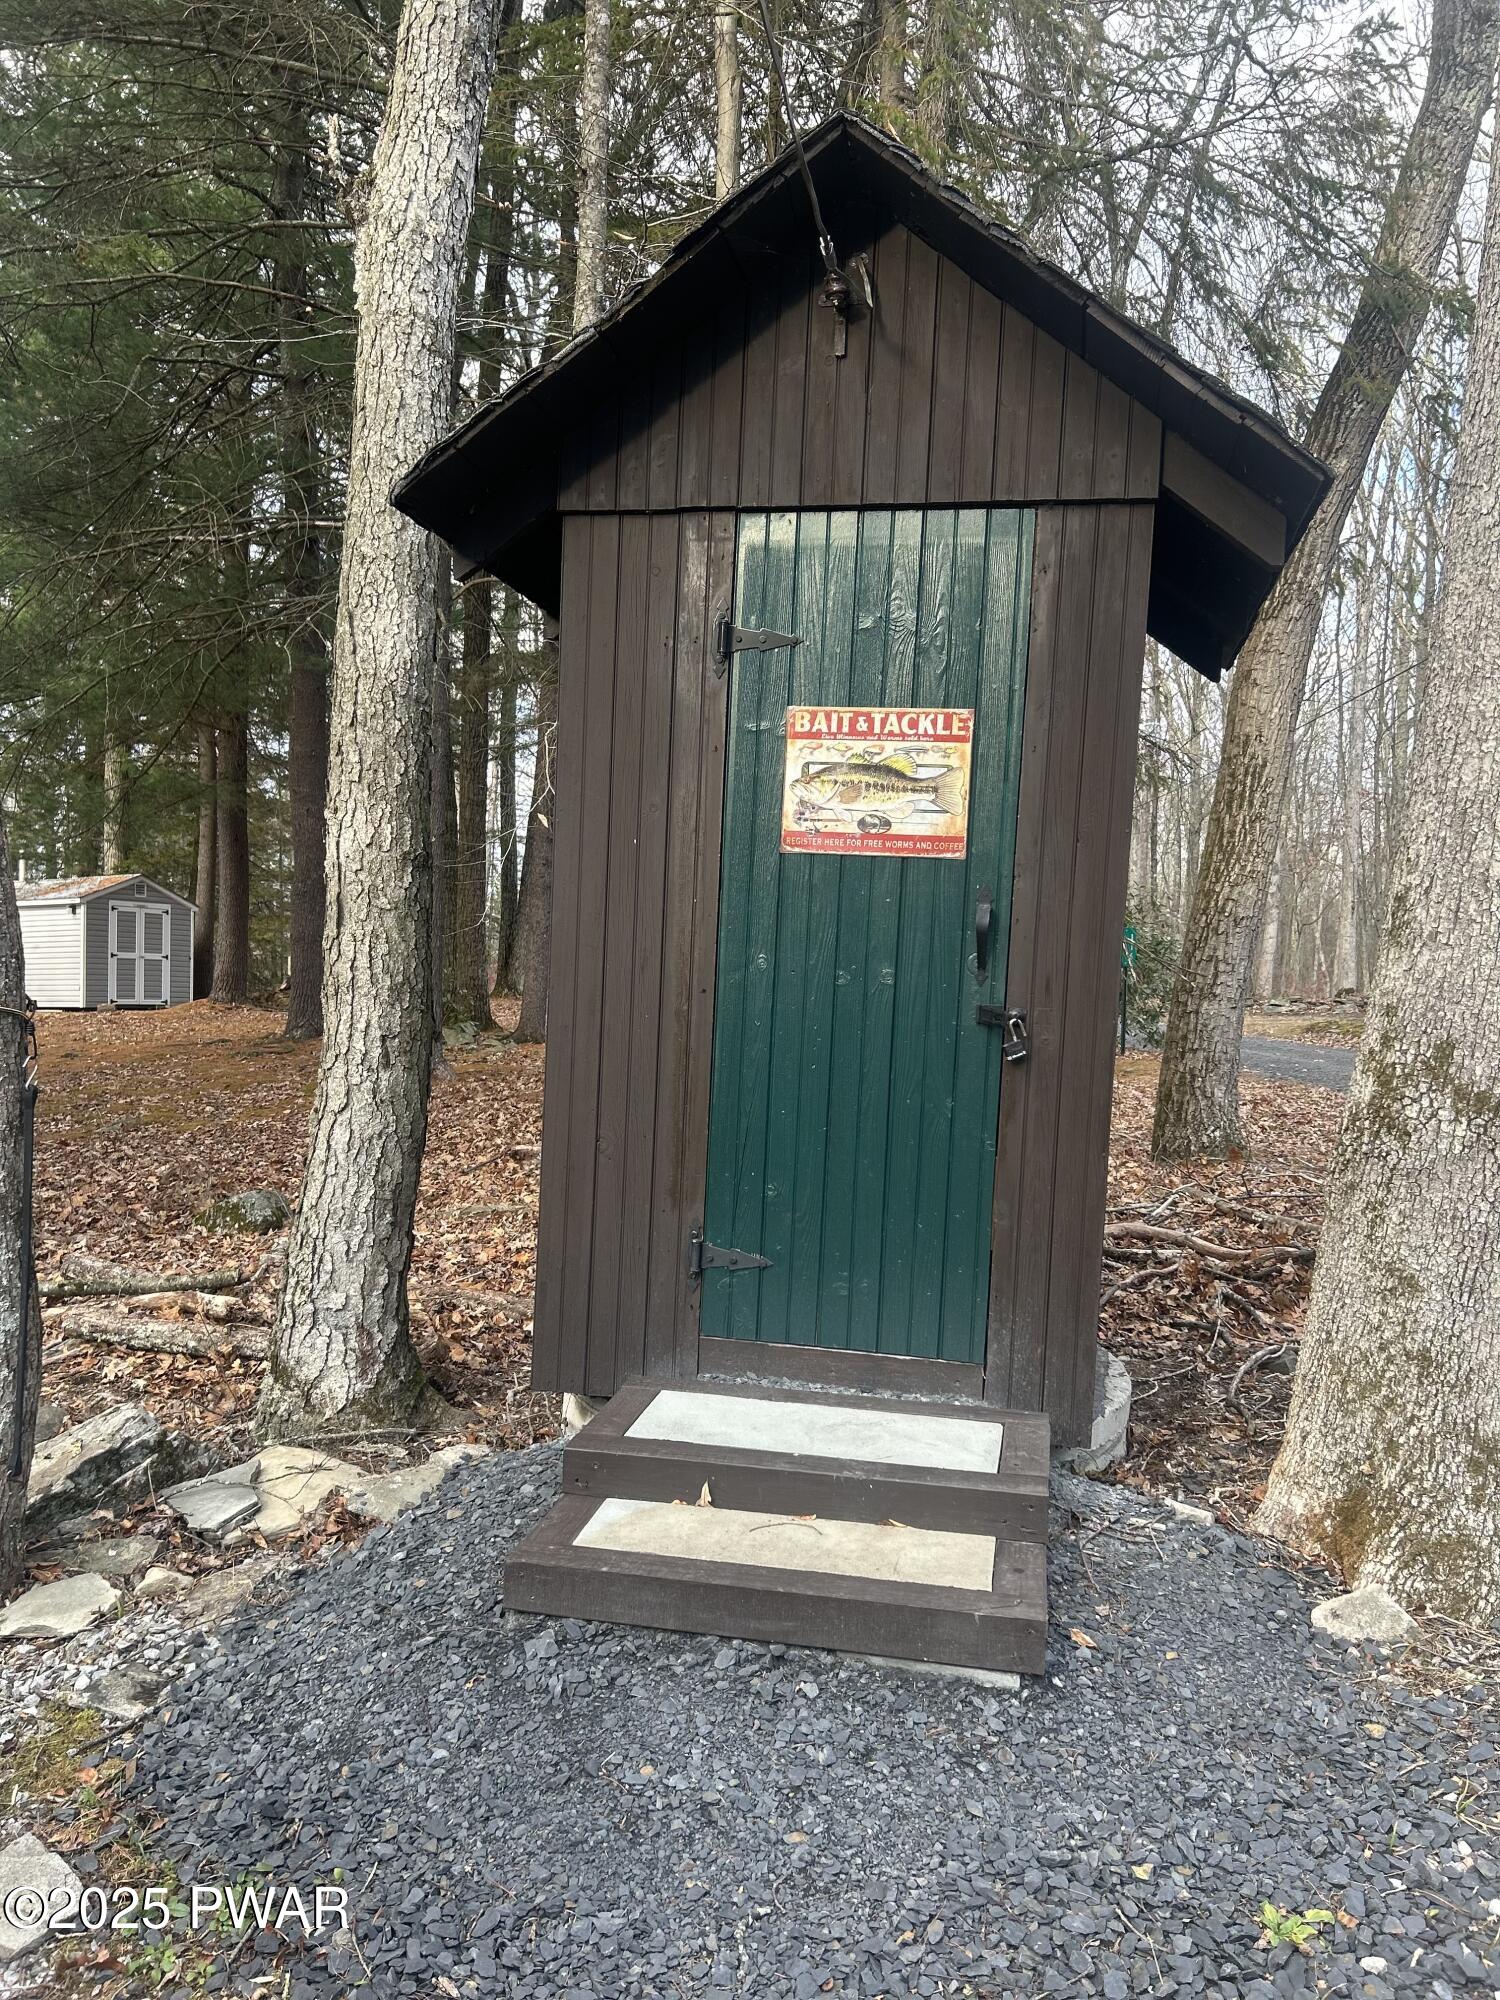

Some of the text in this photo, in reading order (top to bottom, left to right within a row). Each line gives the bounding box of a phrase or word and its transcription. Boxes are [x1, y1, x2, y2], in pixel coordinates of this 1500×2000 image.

[794, 711, 967, 736] BAIT & TACKLE
[786, 837, 964, 851] REGISTER HERE FOR FREE WORMS AND COFFEE
